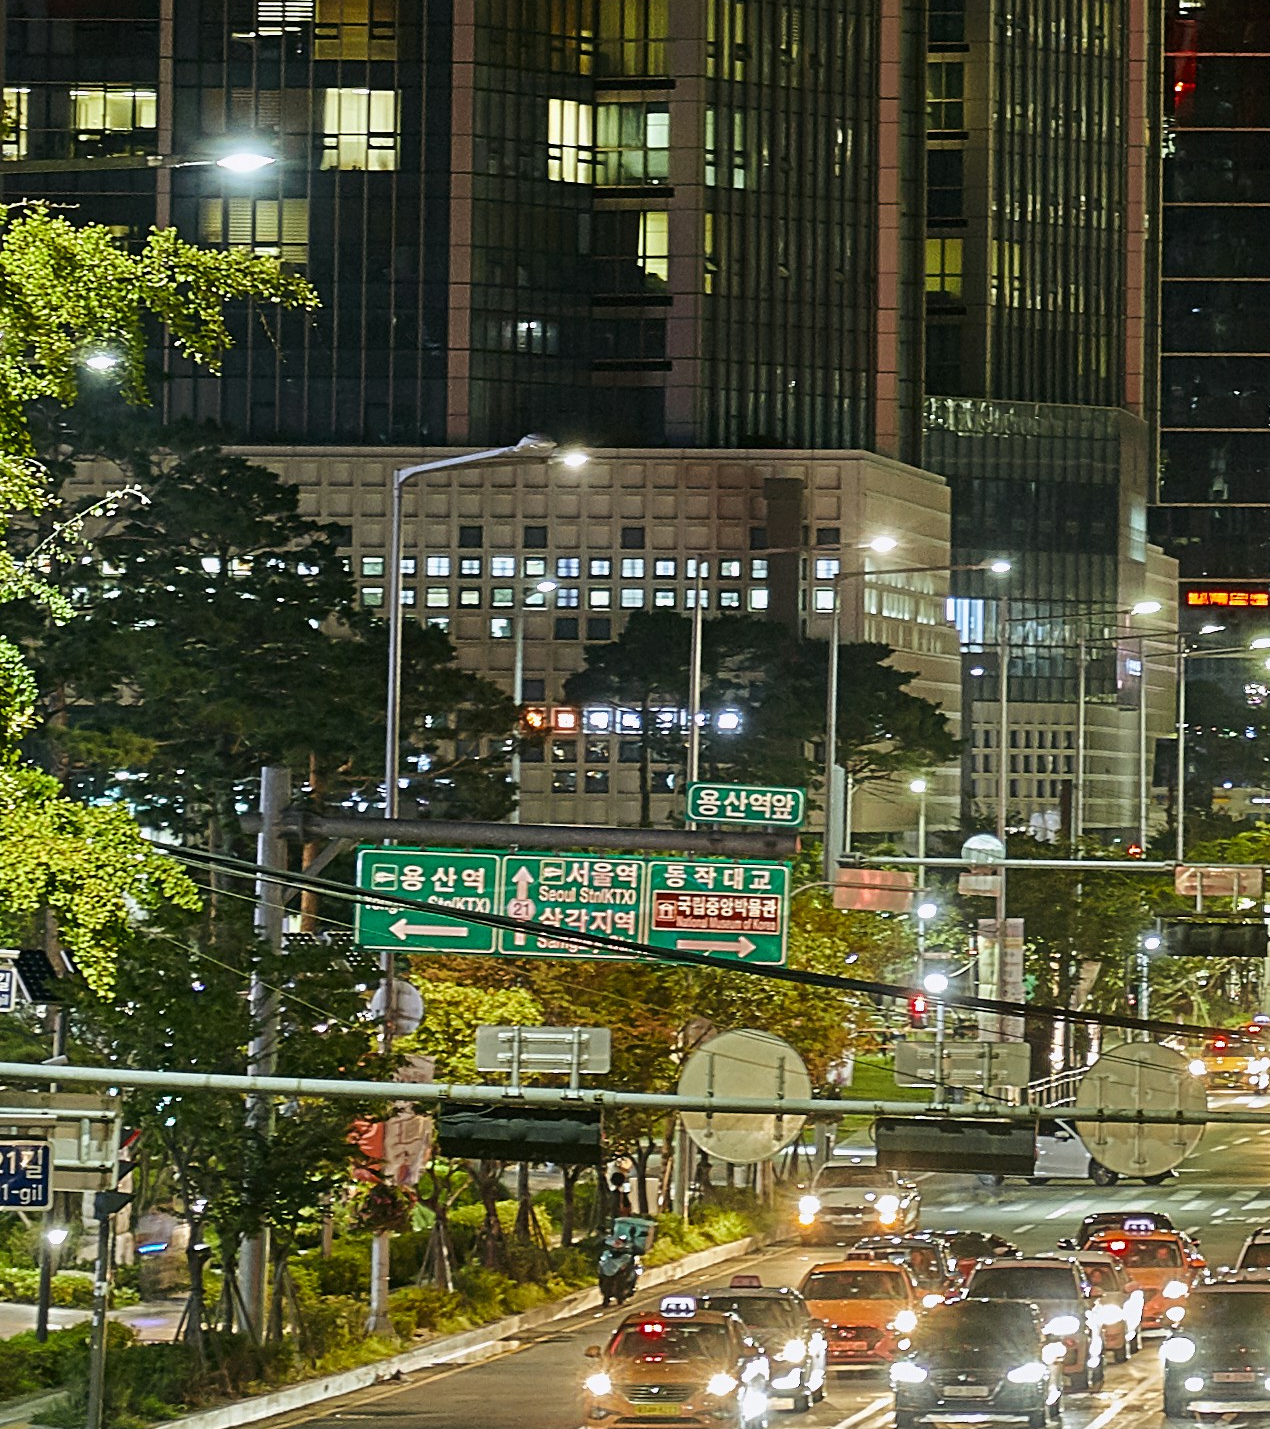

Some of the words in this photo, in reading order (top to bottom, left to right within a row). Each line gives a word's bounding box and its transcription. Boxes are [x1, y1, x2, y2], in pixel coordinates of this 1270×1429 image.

[695, 788, 797, 820] 용산역앞
[399, 864, 487, 894] 용산역
[566, 862, 638, 888] 서울역
[663, 864, 772, 891] 동작대교
[538, 886, 577, 903] Seoul
[579, 888, 637, 905] Stn(KTX)
[677, 896, 777, 919] 국립중앙박물관
[513, 902, 530, 916] 21
[709, 918, 741, 930] Museum
[751, 920, 776, 932] Korea
